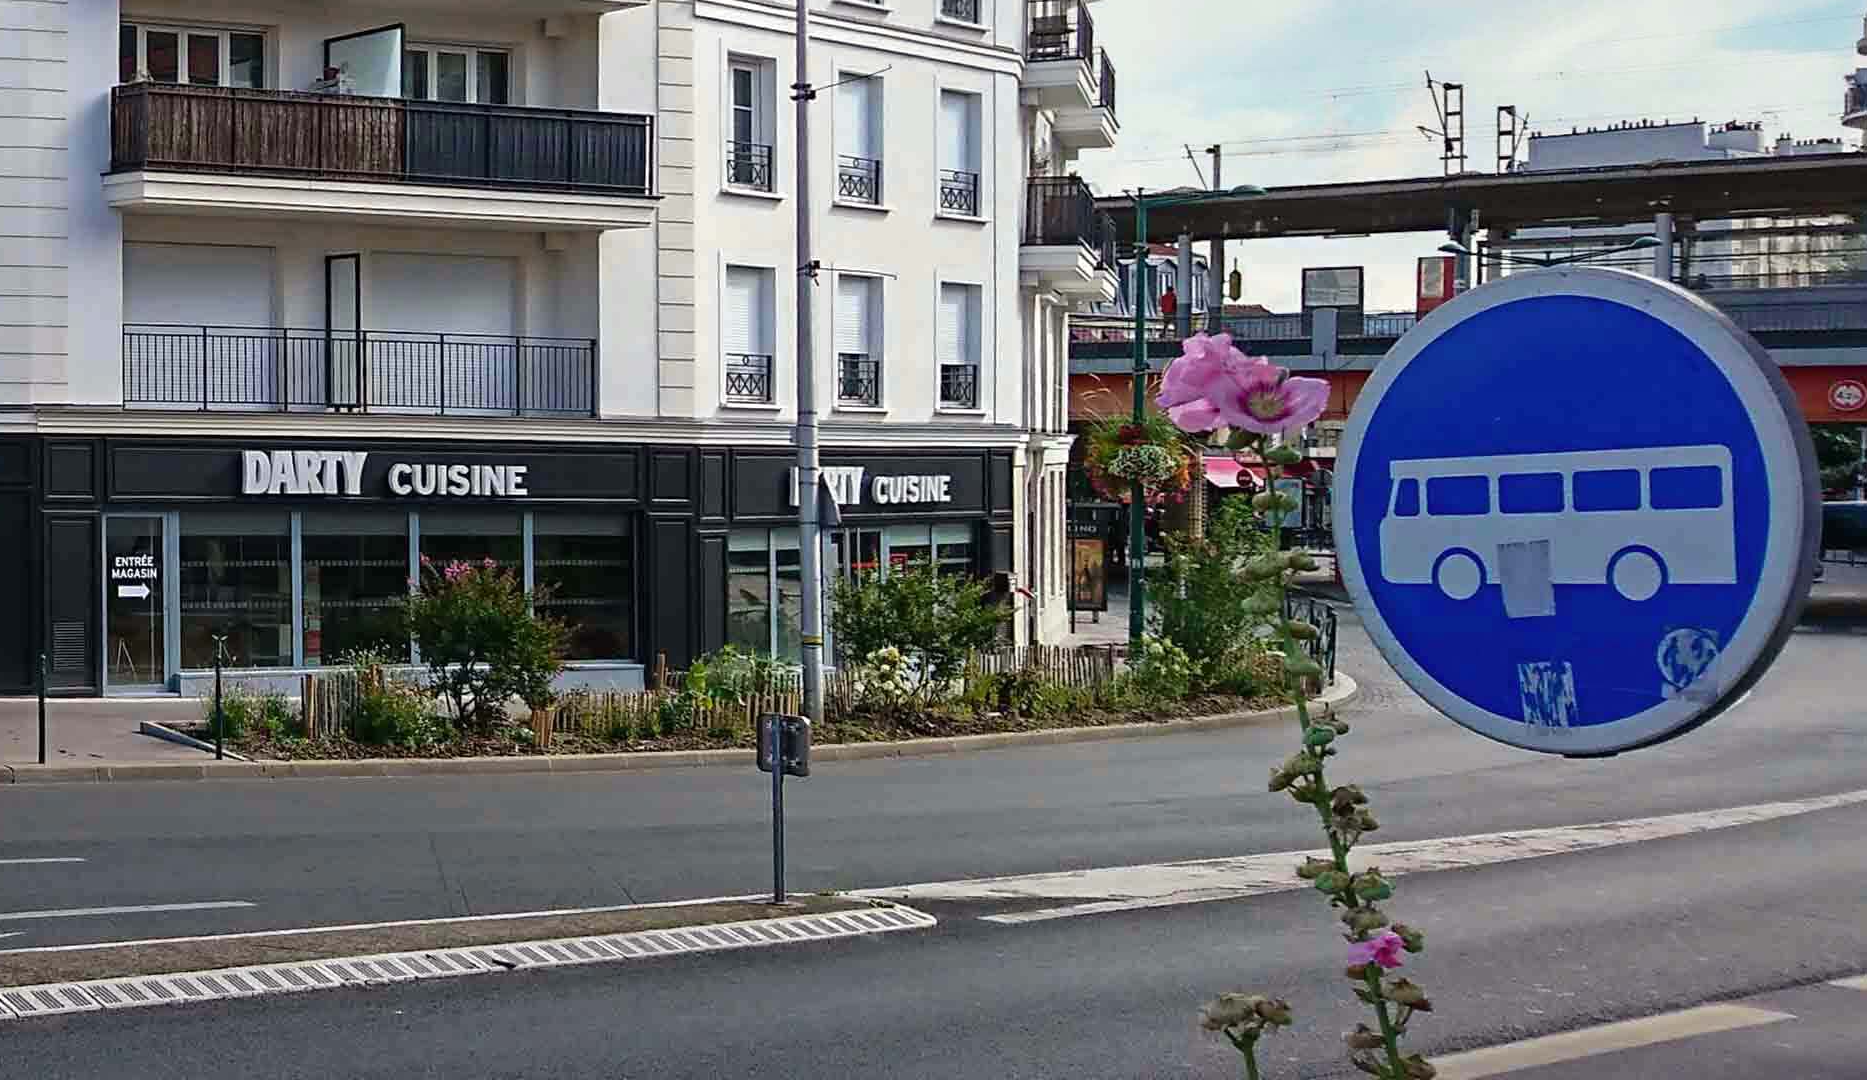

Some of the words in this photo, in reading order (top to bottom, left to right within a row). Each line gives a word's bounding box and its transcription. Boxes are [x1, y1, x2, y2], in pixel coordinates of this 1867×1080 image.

[242, 450, 368, 494] DARTY
[388, 464, 528, 496] CUISINE
[872, 475, 951, 504] CUISINE
[115, 554, 154, 567] ENTRÉE
[111, 568, 157, 579] MAGASIN
